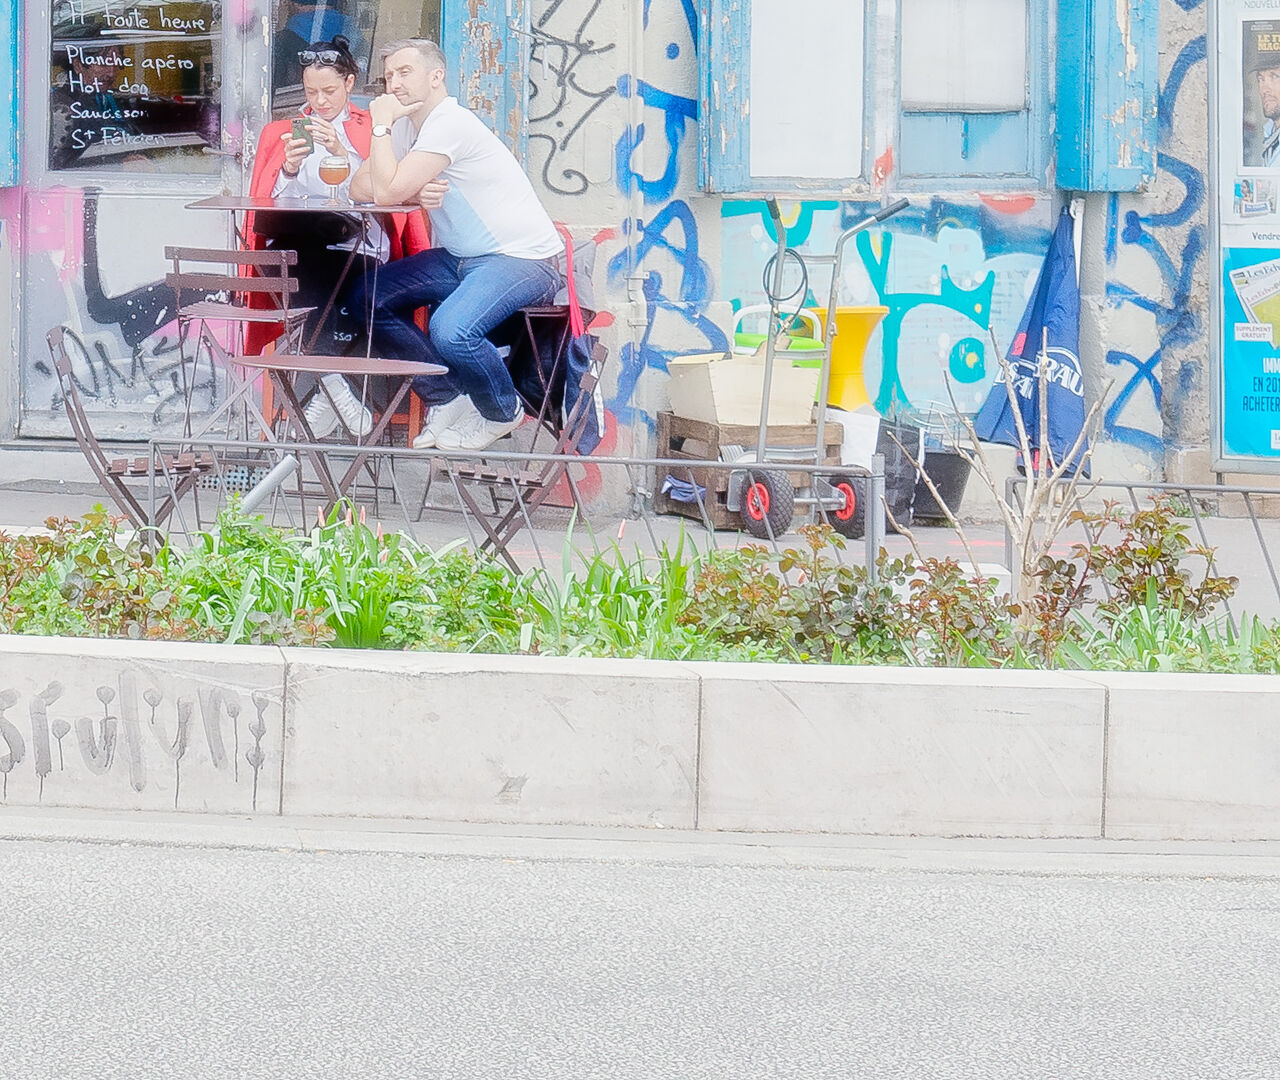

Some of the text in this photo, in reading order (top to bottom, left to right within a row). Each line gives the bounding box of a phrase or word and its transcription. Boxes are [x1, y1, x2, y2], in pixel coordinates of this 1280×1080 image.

[102, 2, 150, 28] toute
[159, 7, 206, 30] heure
[65, 44, 134, 67] Planche
[68, 70, 104, 93] Hot
[1253, 376, 1263, 393] EN
